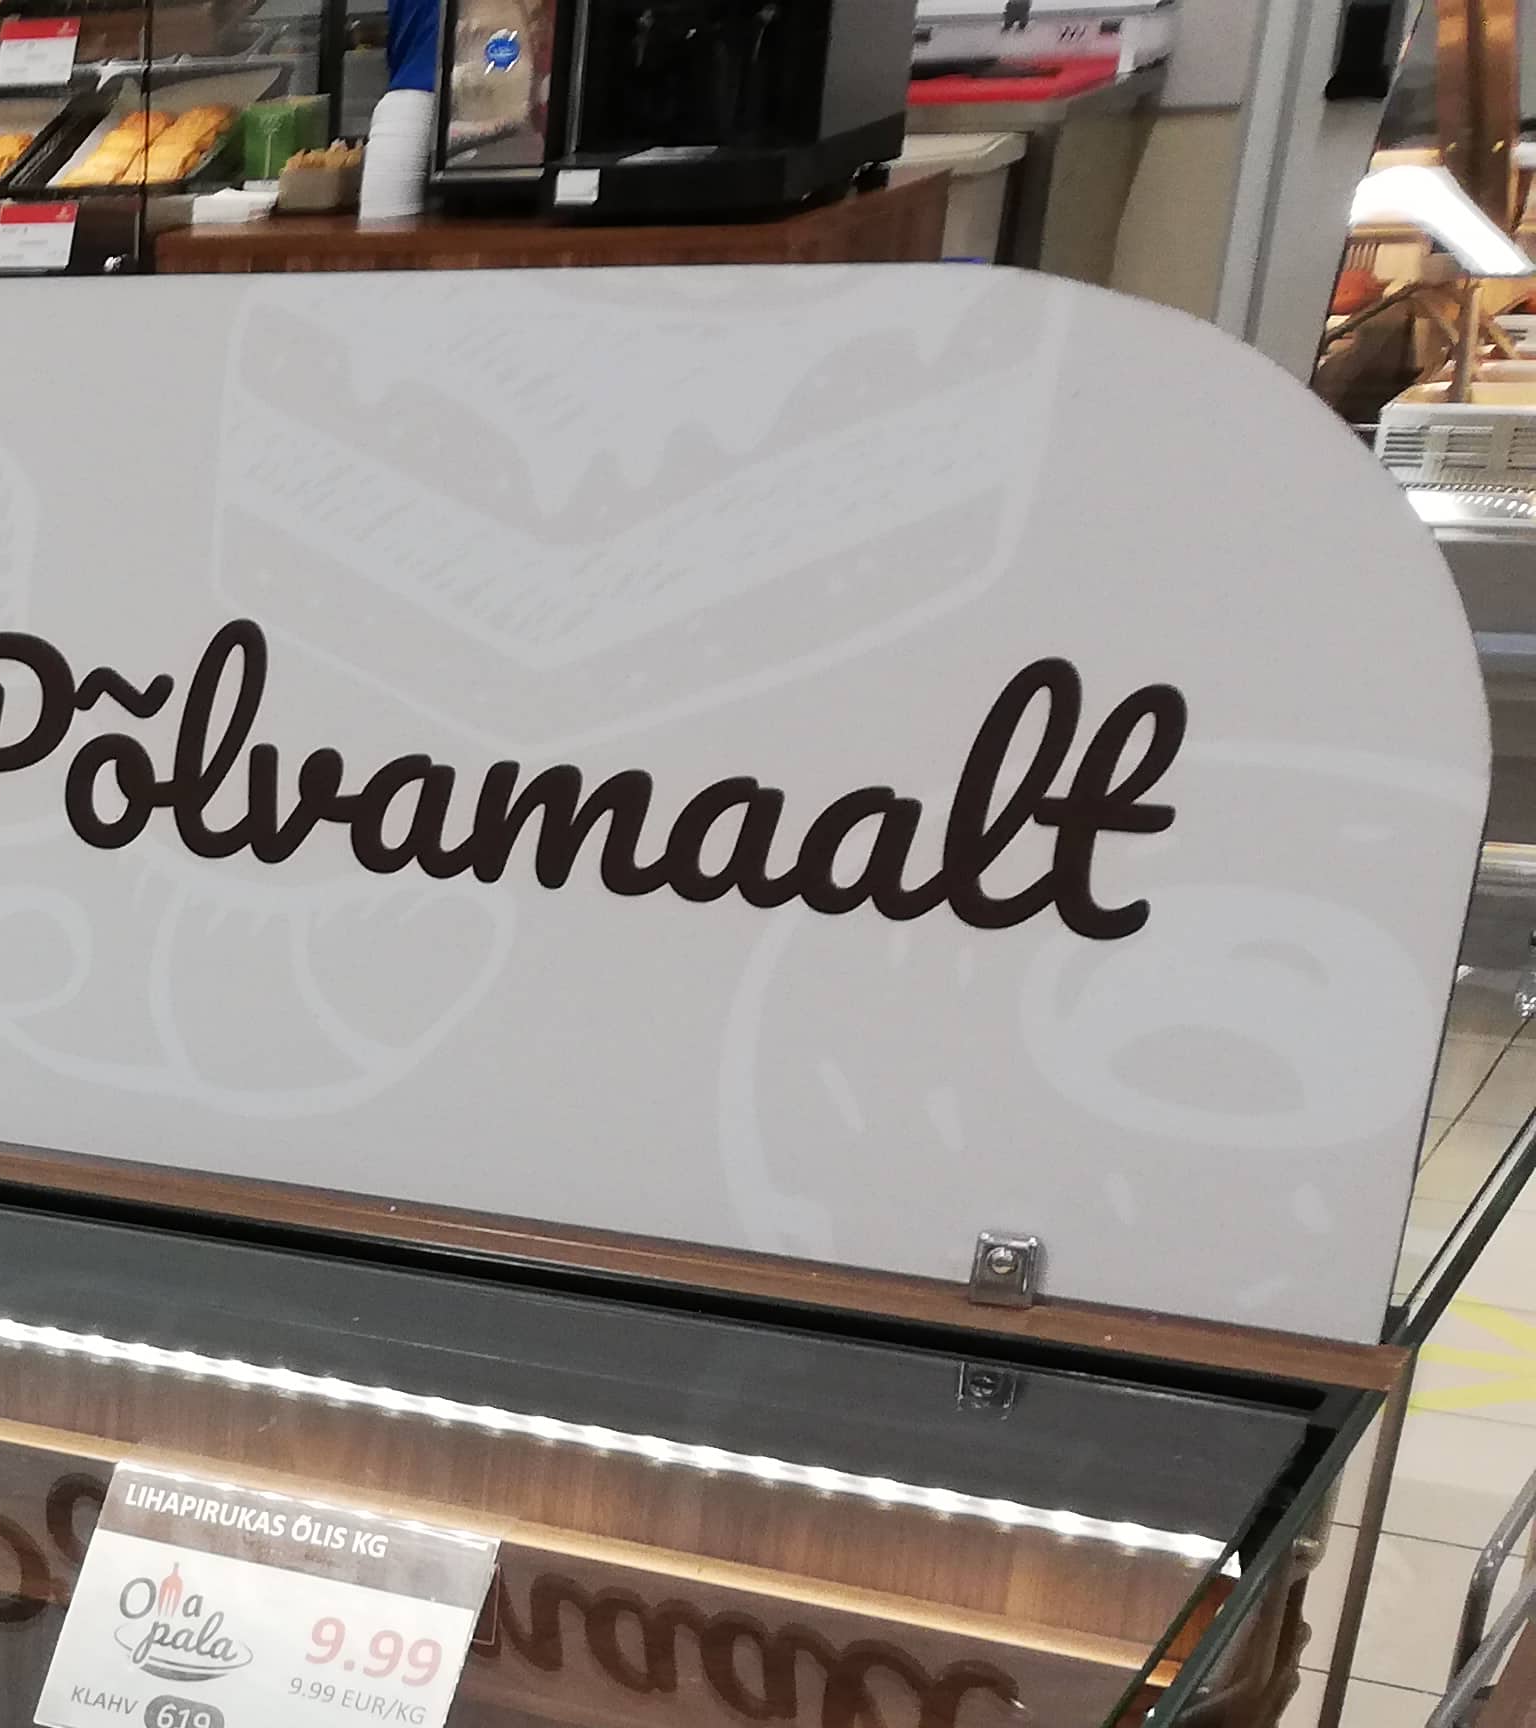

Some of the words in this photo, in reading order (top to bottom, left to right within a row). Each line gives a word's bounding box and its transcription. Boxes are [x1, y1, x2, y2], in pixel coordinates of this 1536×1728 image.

[125, 1483, 286, 1537] LIHAPIRUKAS
[291, 1511, 348, 1551] ÕLIS
[352, 1532, 389, 1560] KG
[131, 1610, 239, 1668] pala
[304, 1616, 443, 1688] 9.99
[70, 1684, 140, 1716] KLAHV
[287, 1675, 336, 1704] 9.99
[340, 1688, 428, 1727] EUR/KG
